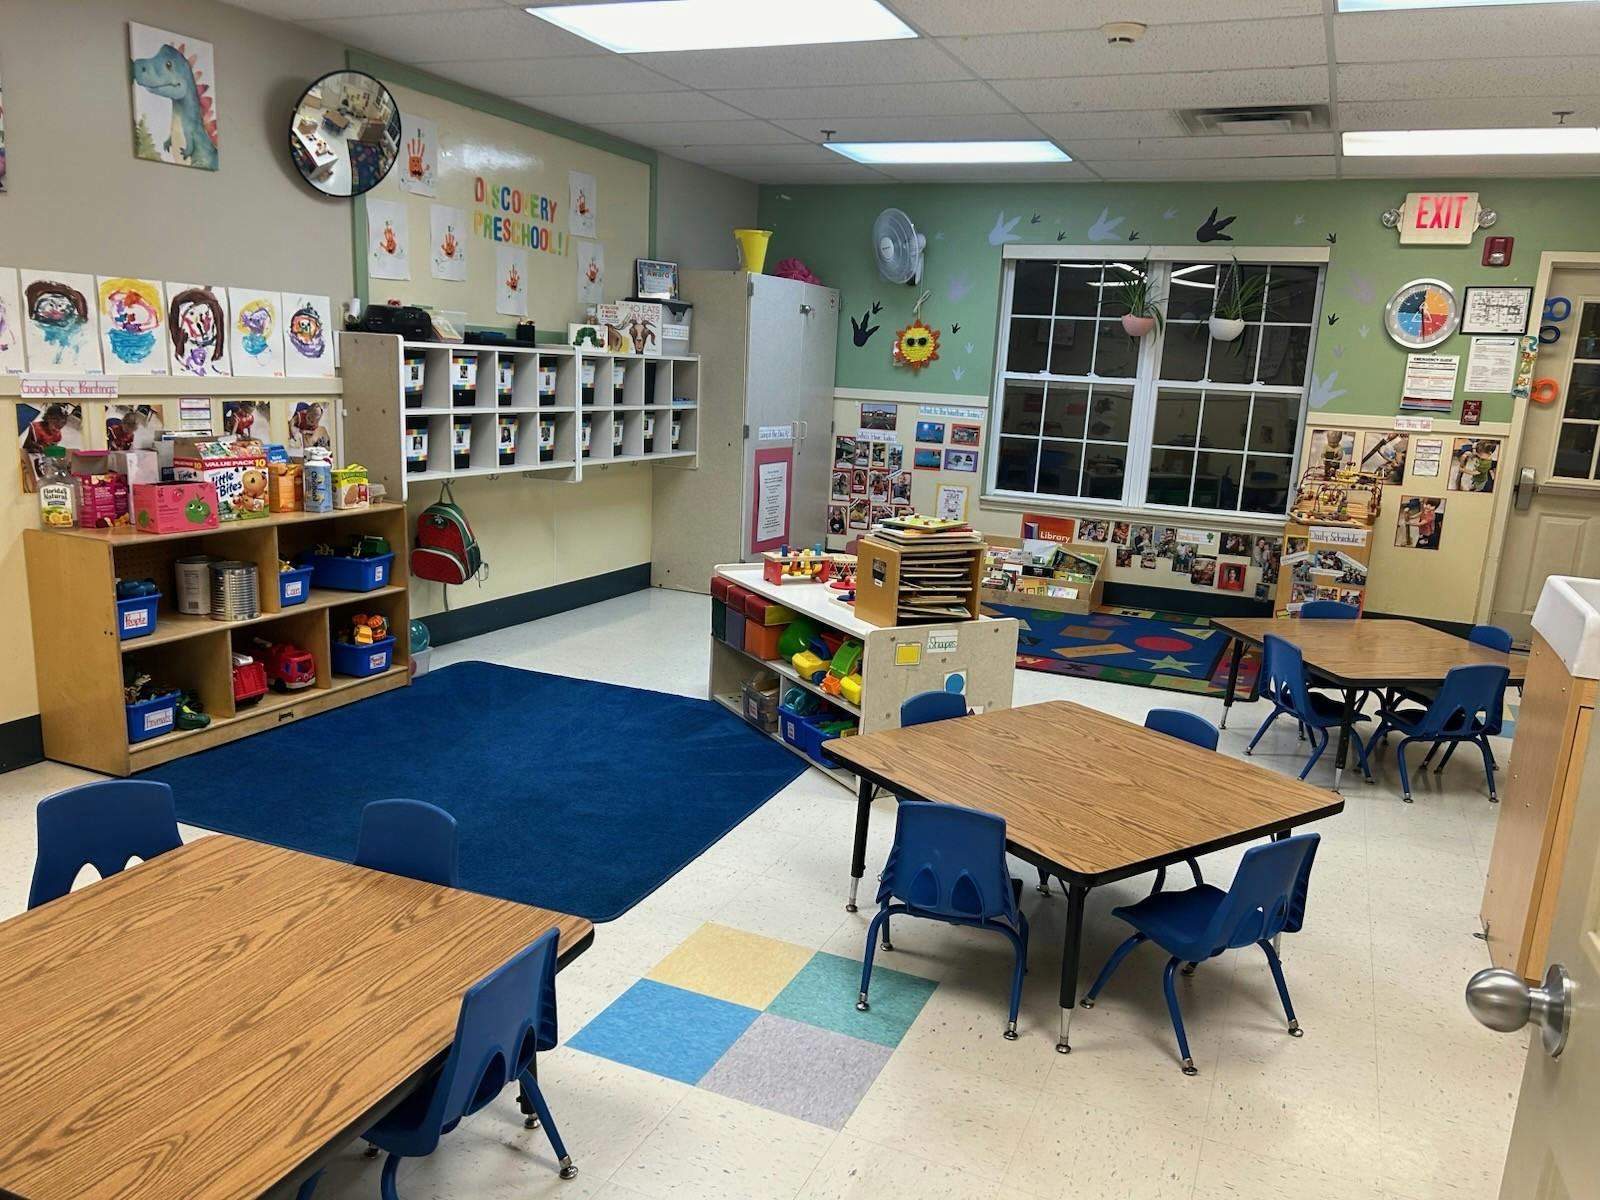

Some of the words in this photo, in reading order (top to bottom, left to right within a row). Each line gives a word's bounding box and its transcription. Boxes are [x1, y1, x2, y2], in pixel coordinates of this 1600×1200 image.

[474, 176, 558, 224] DISCOVERY
[1416, 196, 1469, 229] EXIT
[255, 459, 266, 467] 10
[219, 481, 243, 498] Bites
[1040, 531, 1071, 543] Library
[1310, 530, 1329, 543] Daily
[1329, 531, 1359, 544] Schedule
[929, 636, 957, 650] Shapes
